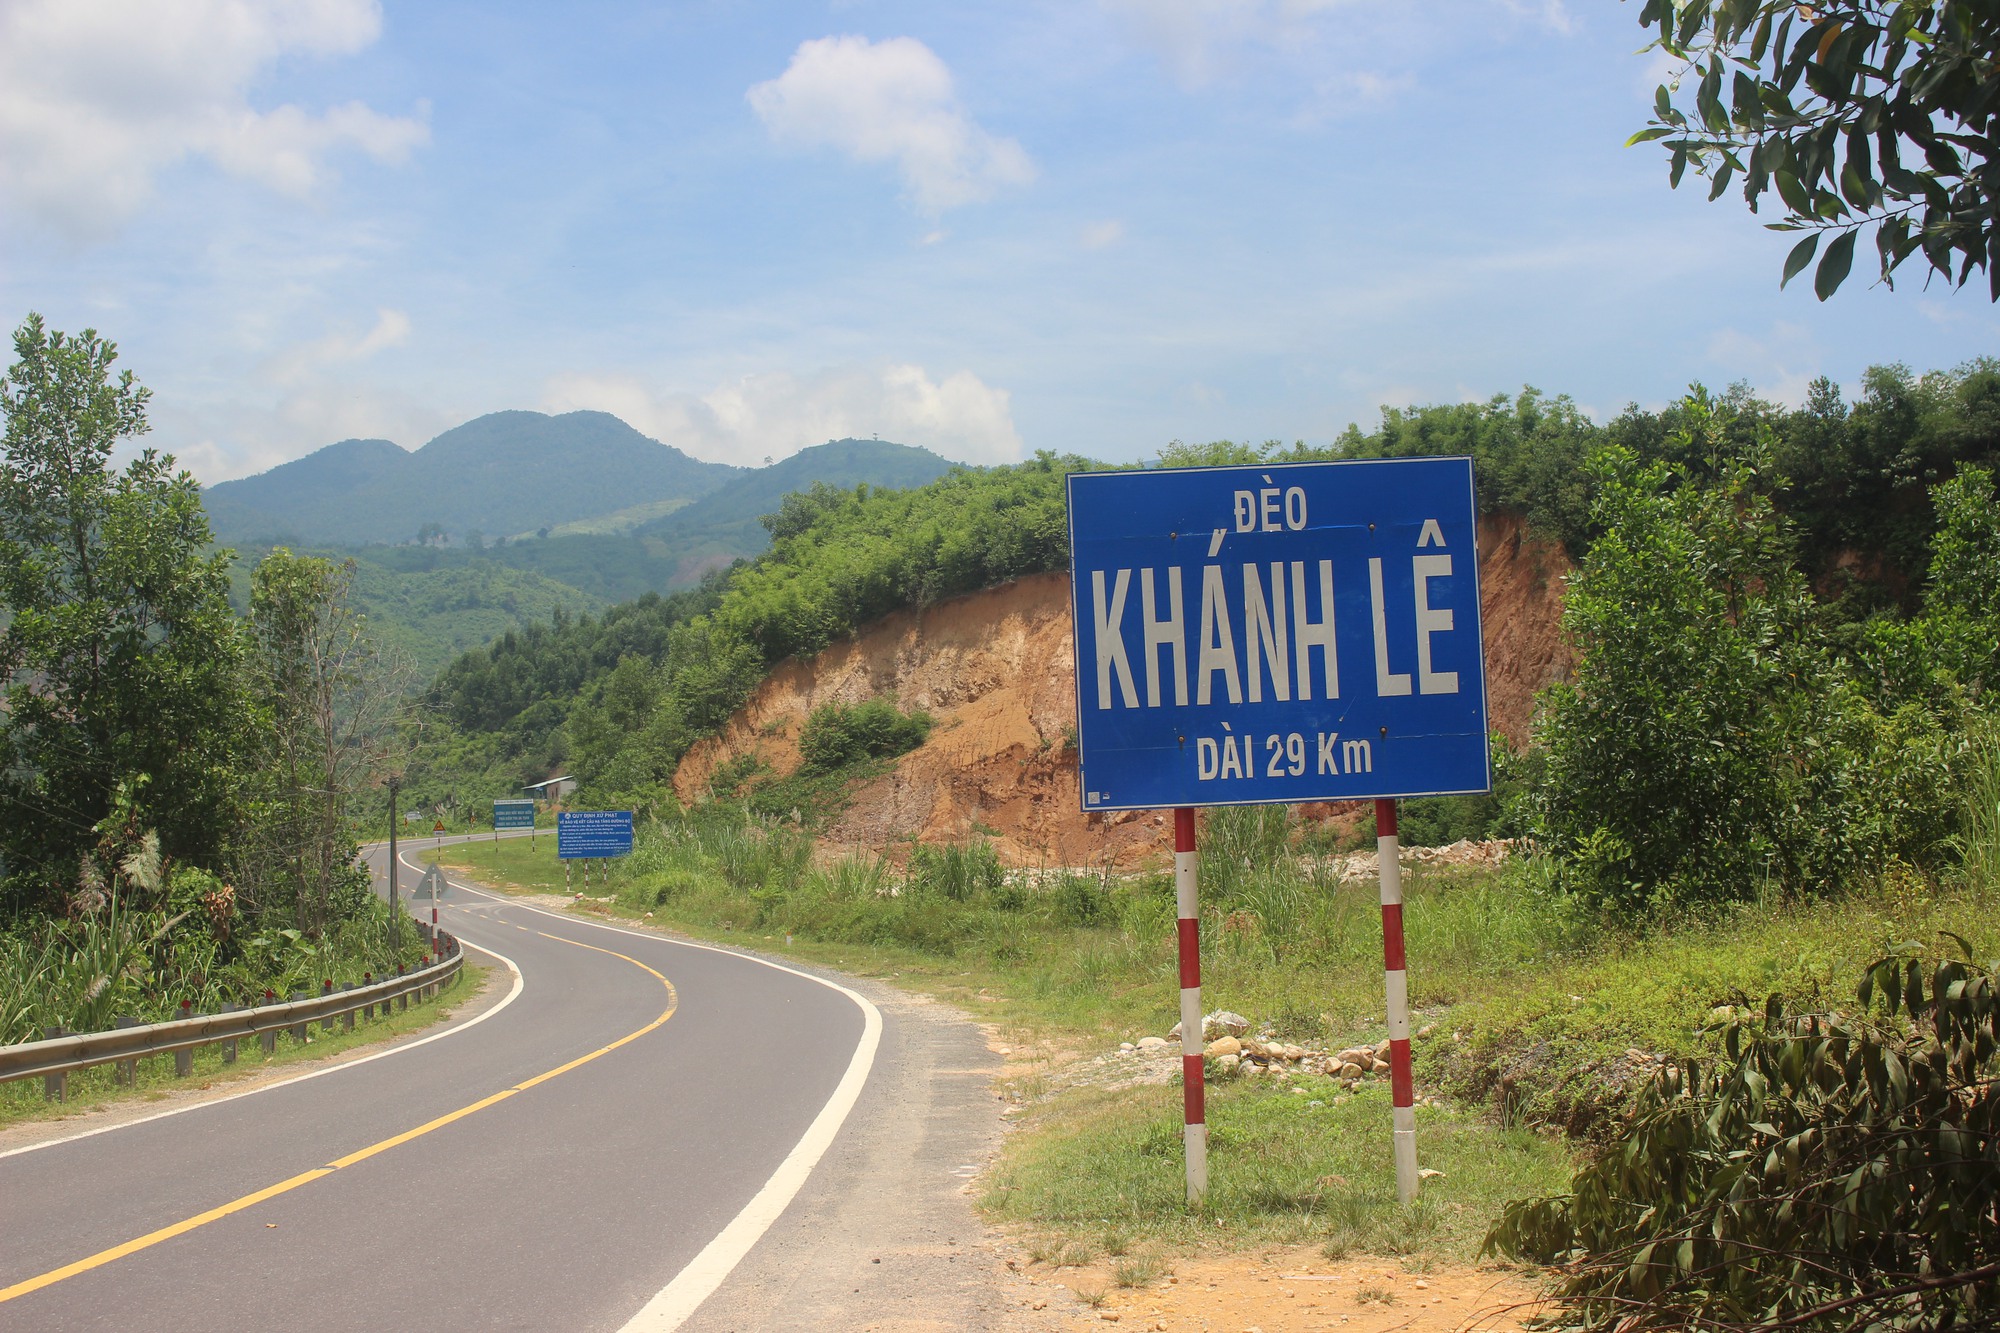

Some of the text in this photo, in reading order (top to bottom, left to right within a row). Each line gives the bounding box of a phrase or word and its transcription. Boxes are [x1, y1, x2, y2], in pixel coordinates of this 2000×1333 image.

[1233, 474, 1308, 533] ĐÈO
[1091, 518, 1460, 710] KHÁNH LÊ
[1196, 721, 1373, 781] DÀI 29 Km
